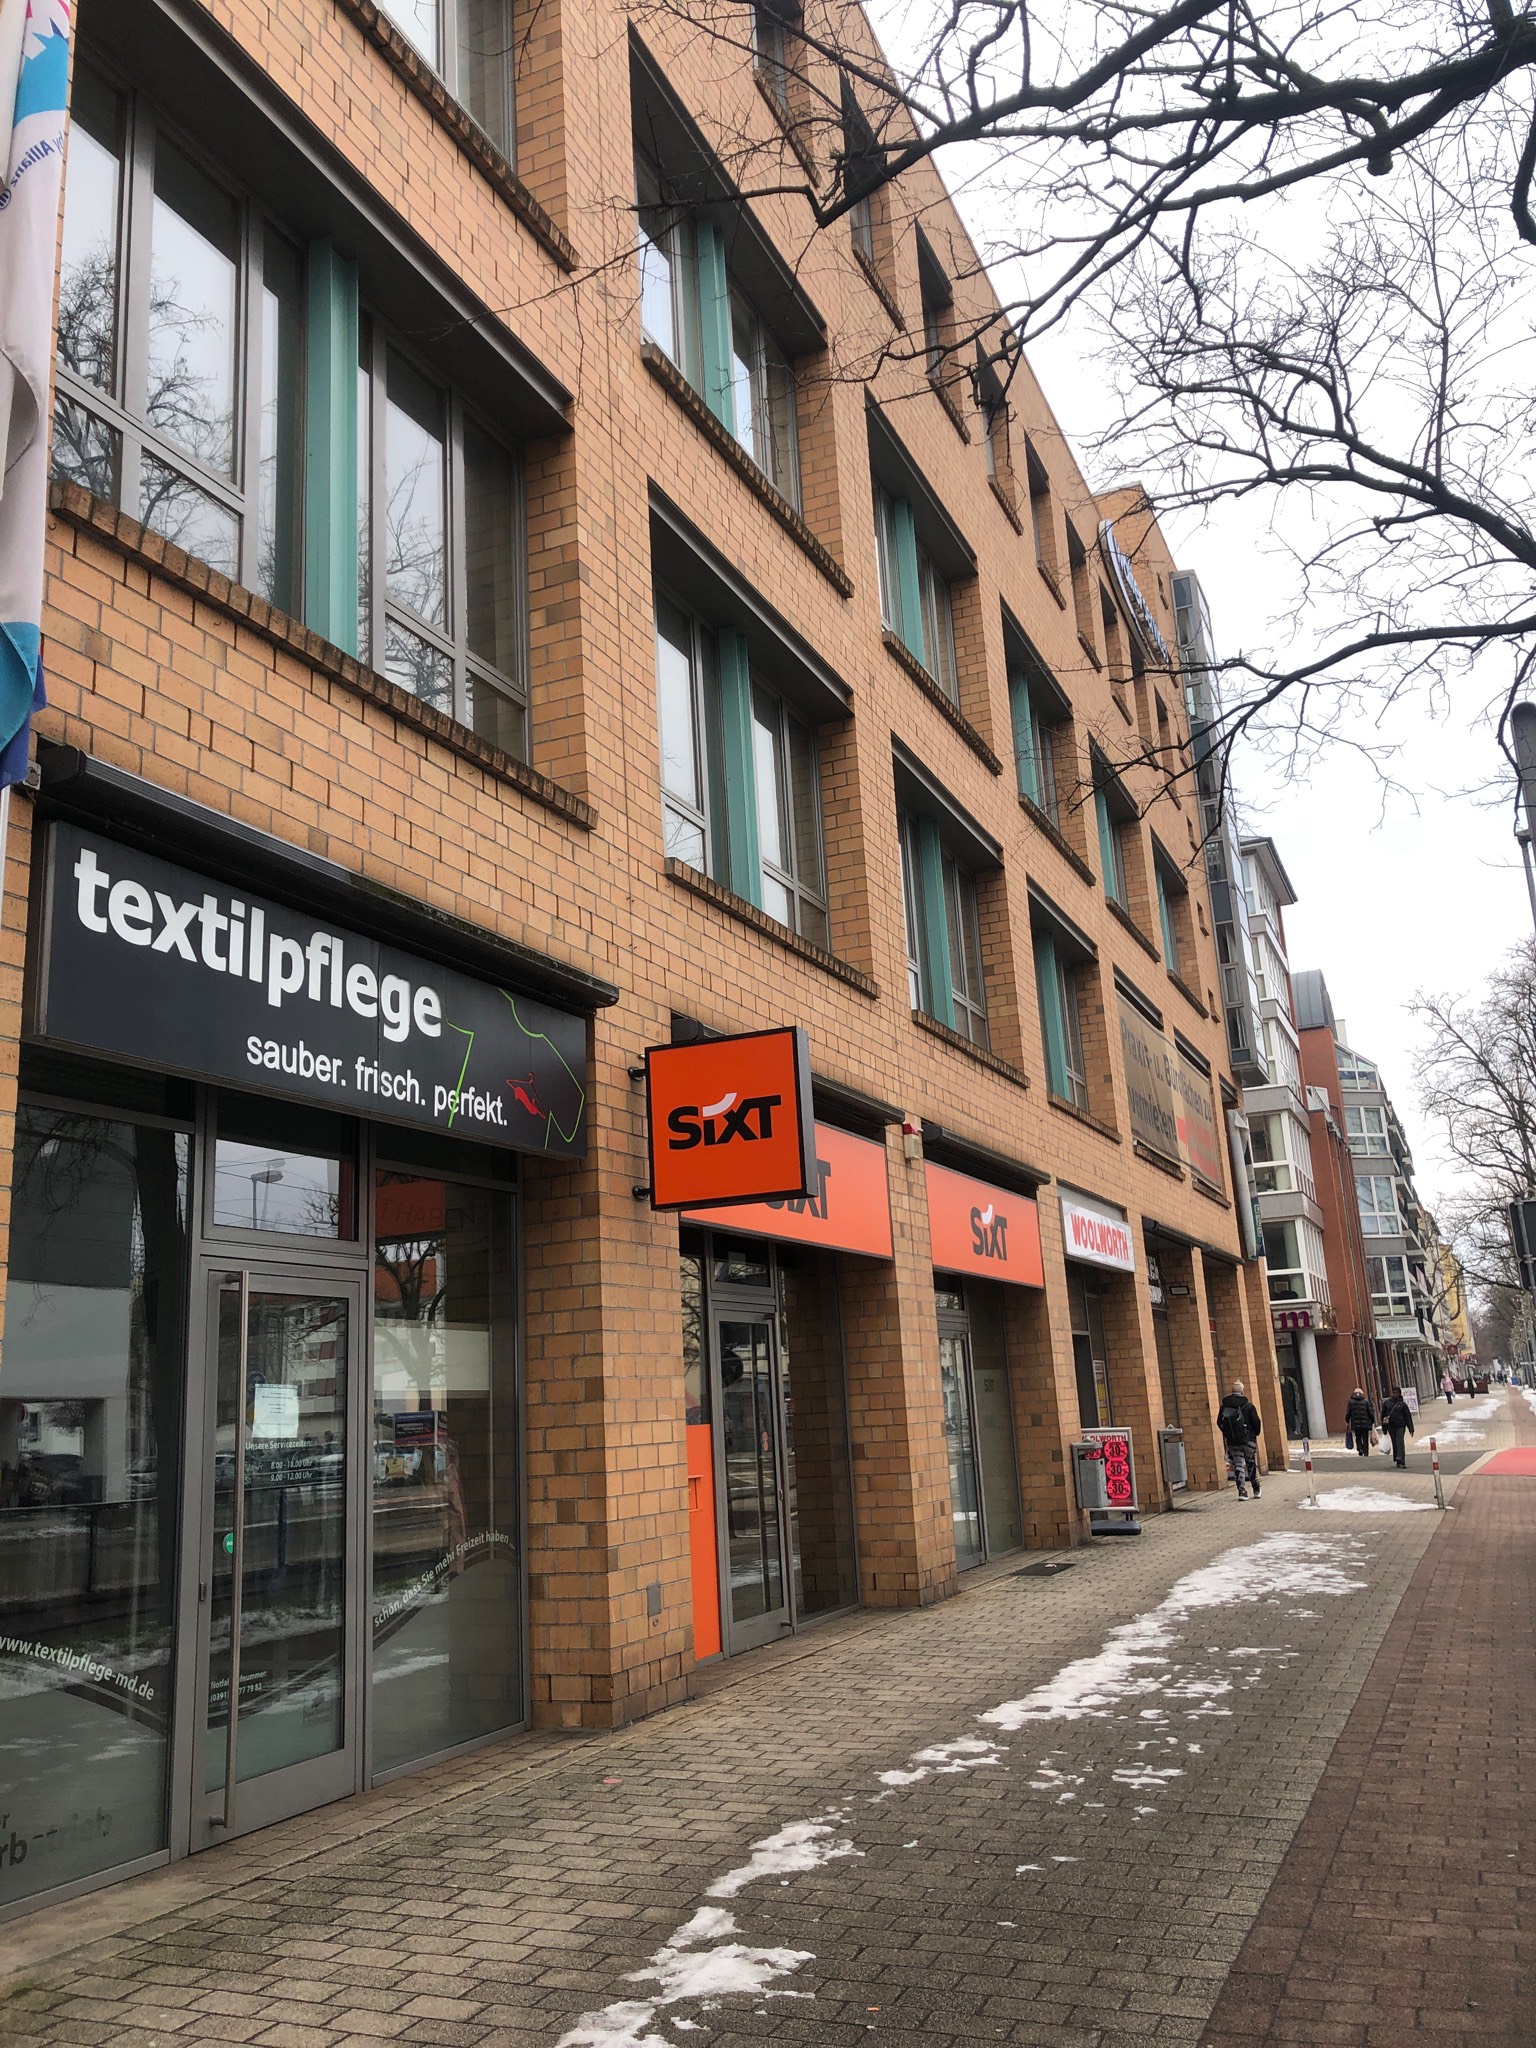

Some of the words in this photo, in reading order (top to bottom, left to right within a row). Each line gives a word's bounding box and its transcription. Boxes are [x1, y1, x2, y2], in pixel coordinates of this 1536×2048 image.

[73, 847, 442, 1043] textilpflege
[246, 1035, 347, 1087] sauber.
[354, 1056, 427, 1106] frisch.
[433, 1082, 508, 1126] perfekt.
[1070, 1212, 1130, 1261] WOOLWORTH
[245, 1441, 269, 1451] Unsere
[421, 1570, 435, 1586] Sie
[435, 1551, 456, 1574] mehr
[455, 1532, 485, 1557] Freizeit
[485, 1530, 509, 1544] haben
